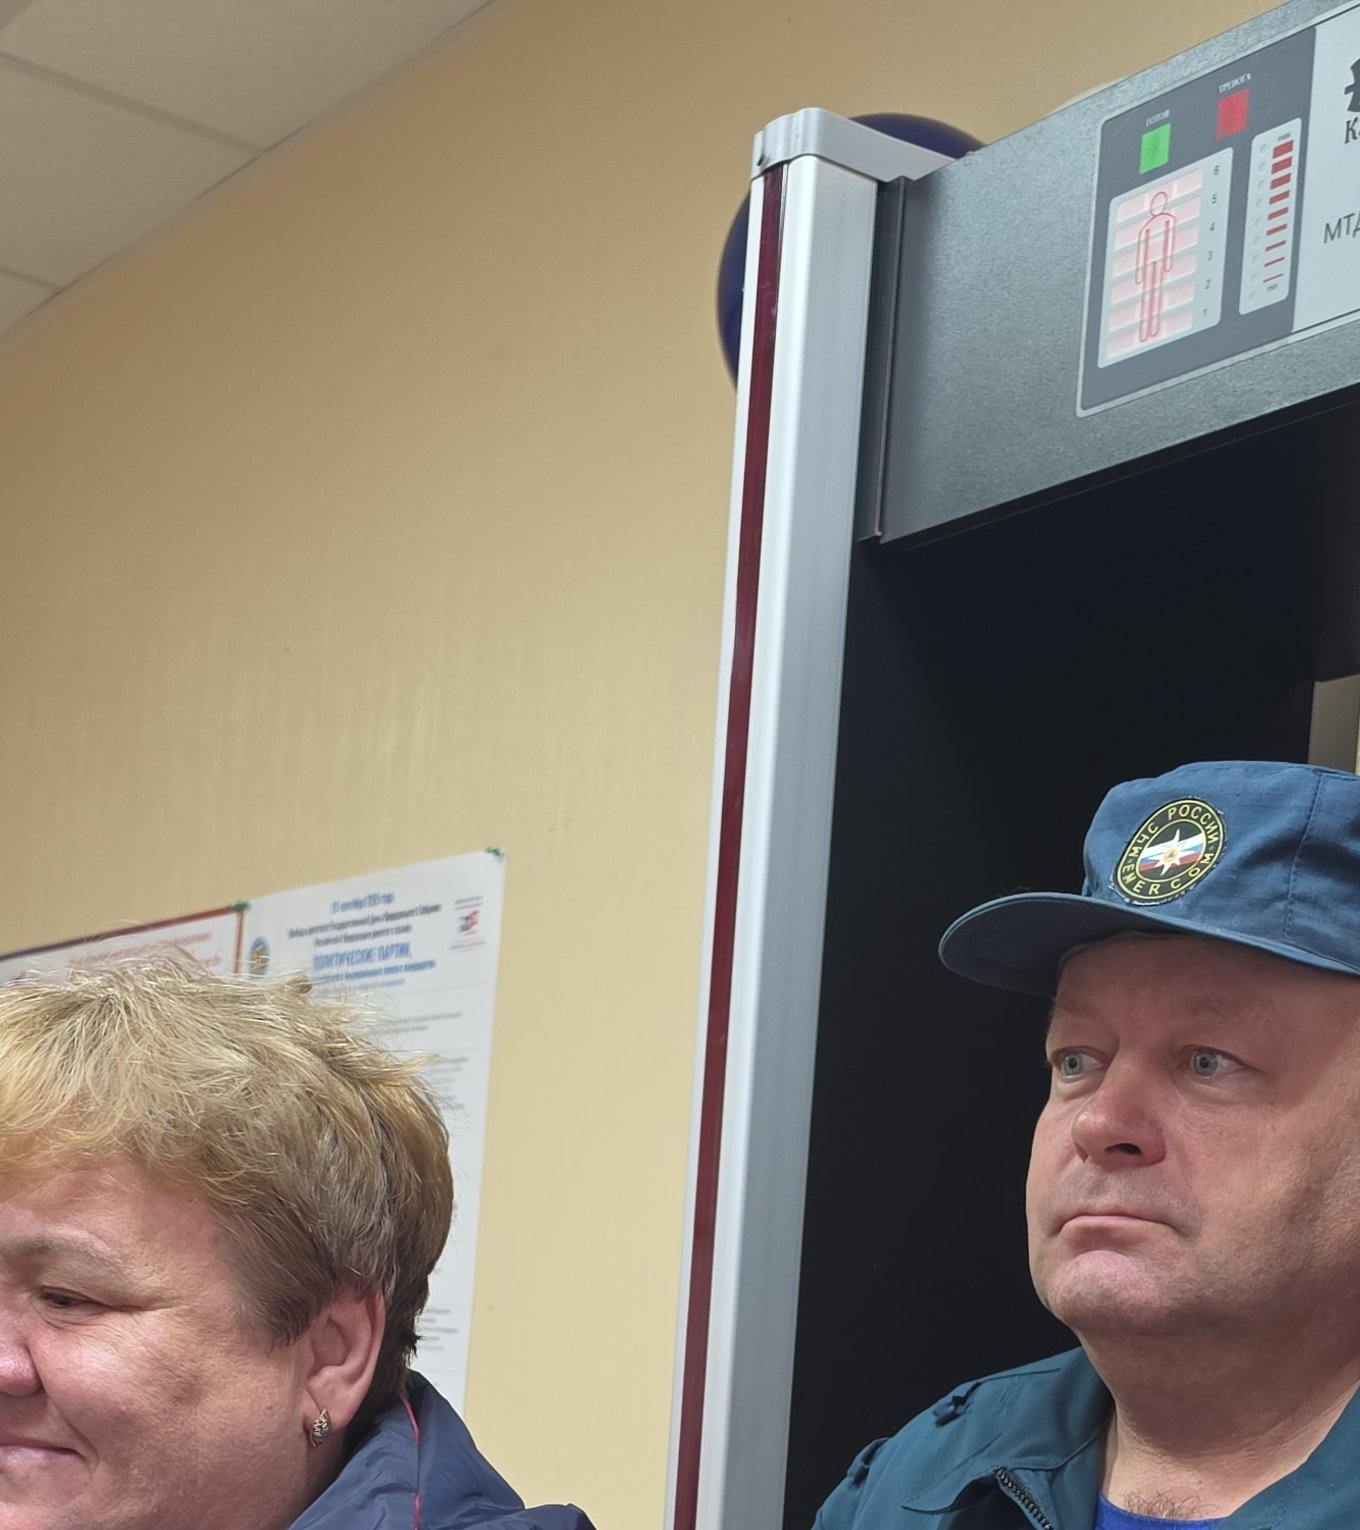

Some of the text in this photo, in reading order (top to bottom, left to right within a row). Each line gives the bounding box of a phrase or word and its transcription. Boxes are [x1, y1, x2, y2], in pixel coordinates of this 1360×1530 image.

[1212, 164, 1221, 177] 6
[1128, 804, 1220, 858] МЧС РОССИИ
[1121, 852, 1215, 896] EMERCOM
